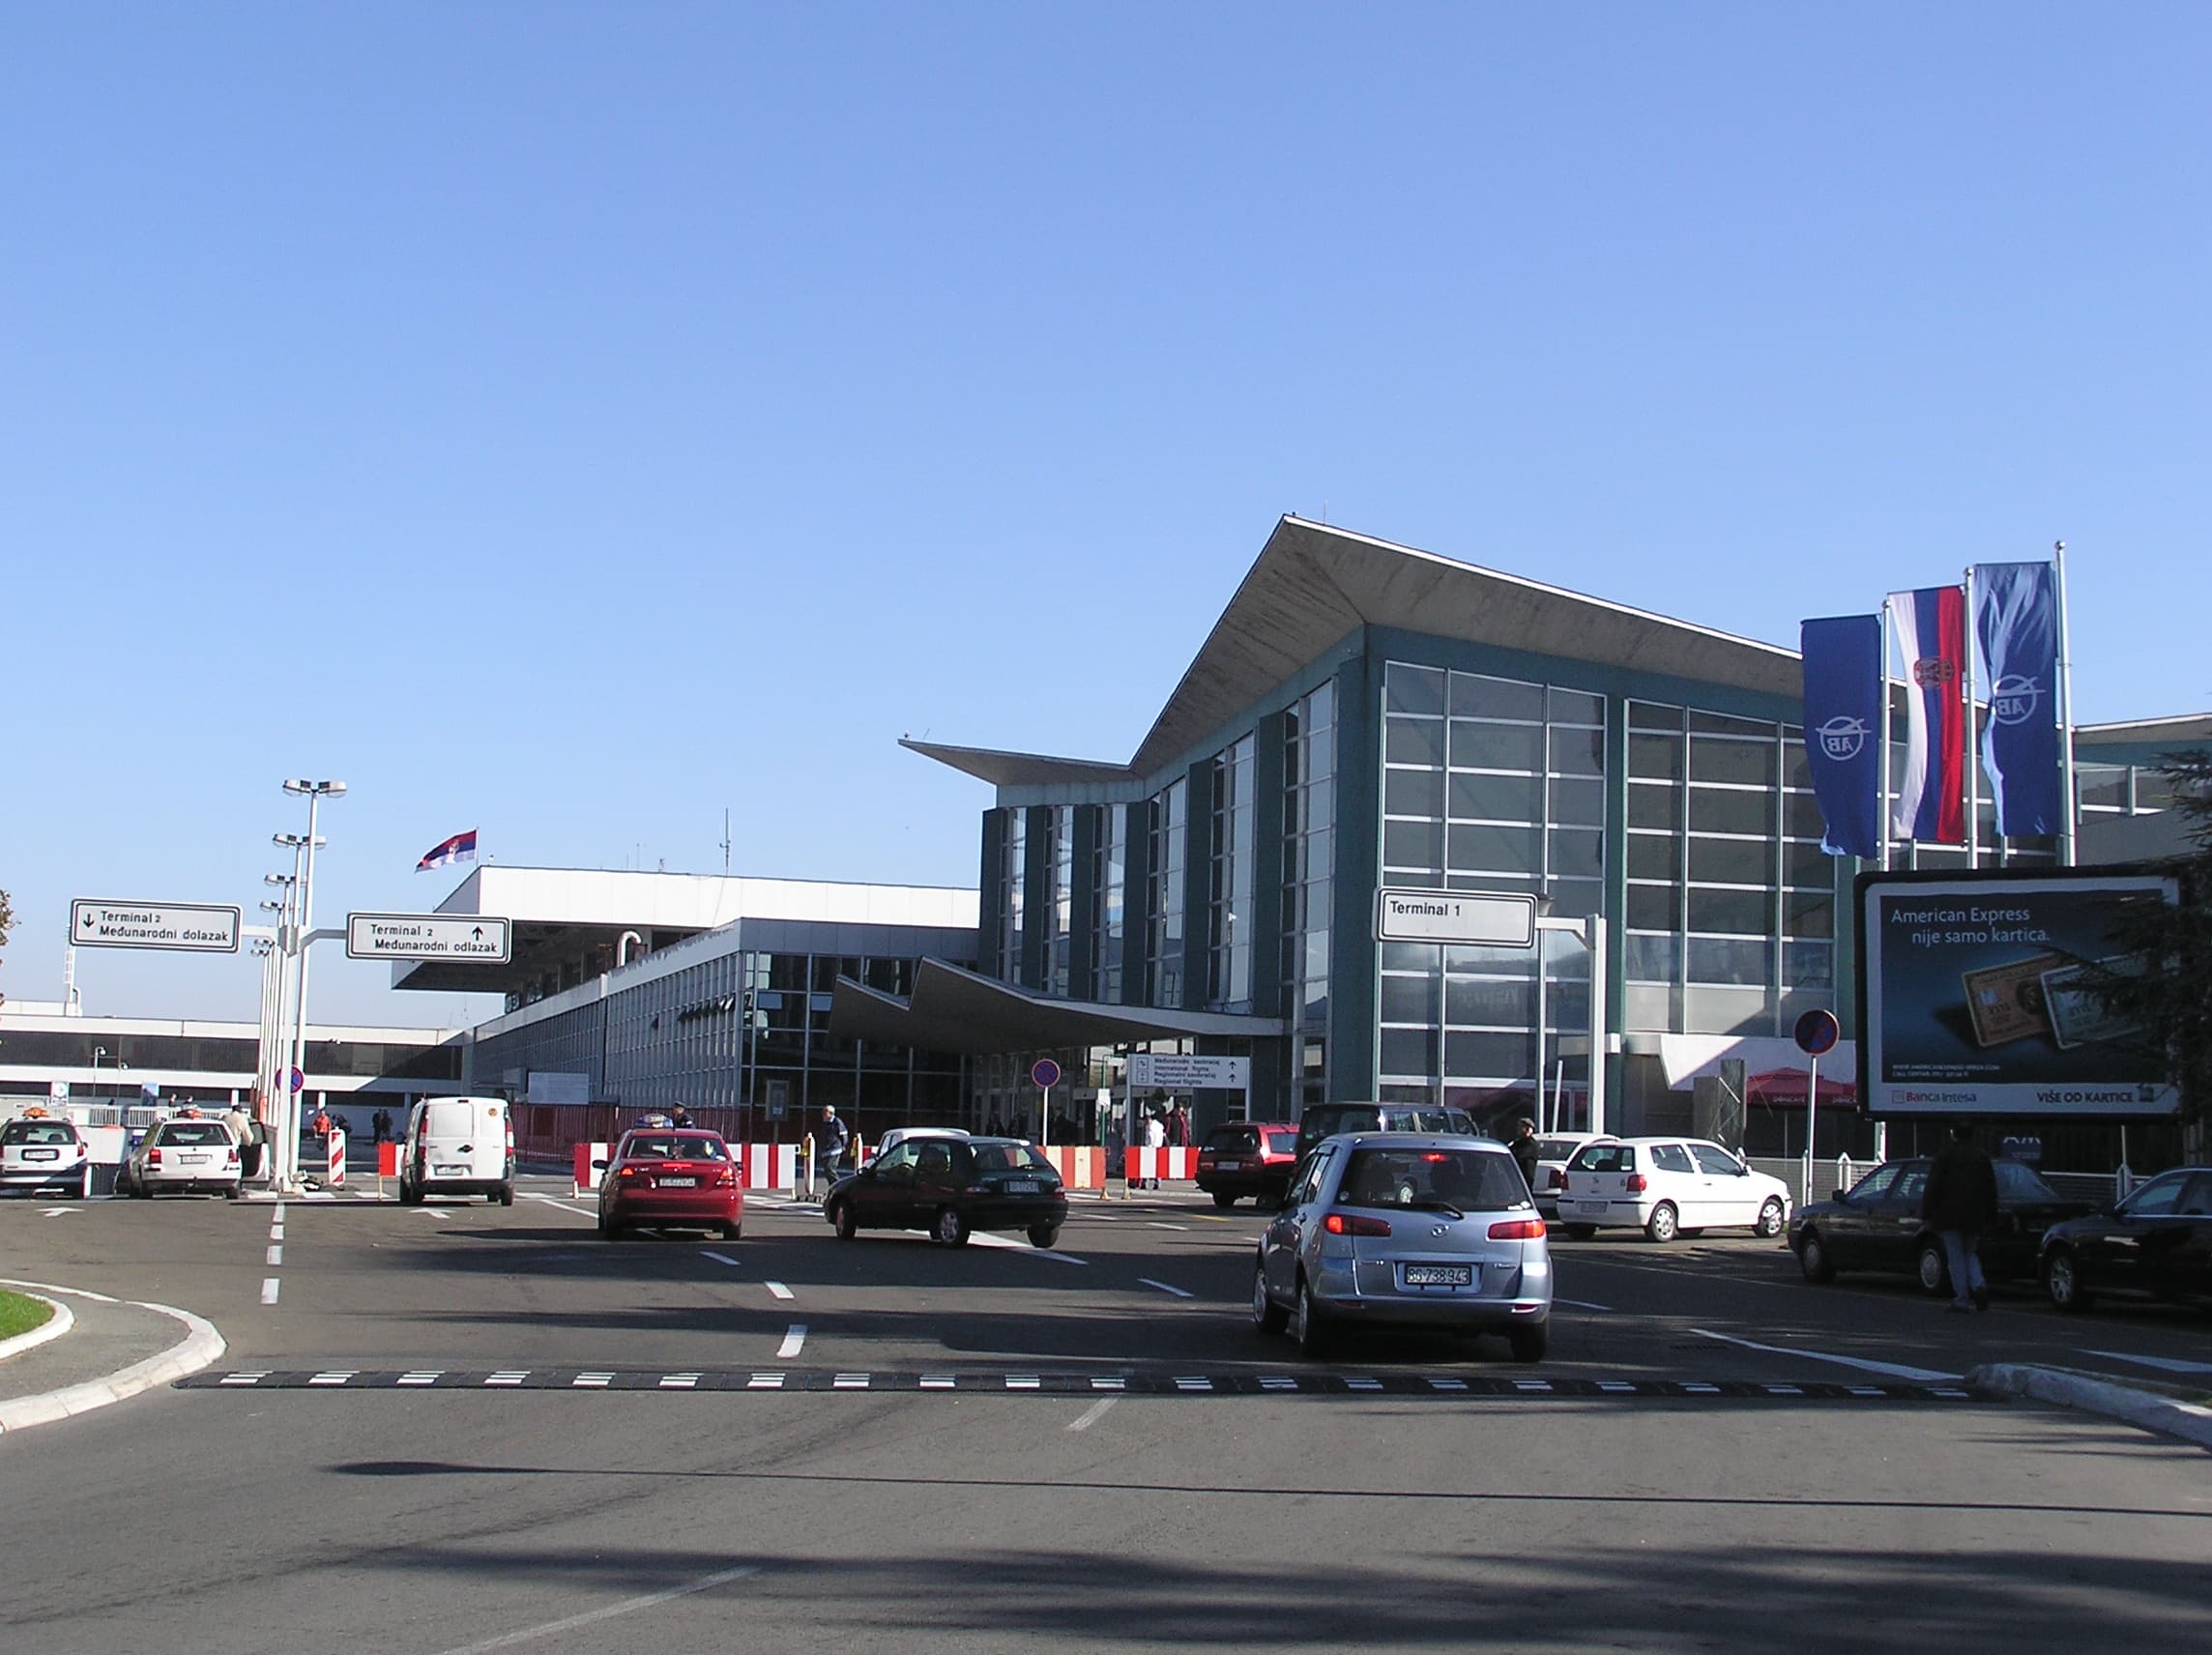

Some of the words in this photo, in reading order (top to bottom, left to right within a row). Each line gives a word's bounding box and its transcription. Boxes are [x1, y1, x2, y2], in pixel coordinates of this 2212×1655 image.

[1389, 900, 1448, 916] Terminal
[1454, 904, 1461, 916] 1
[101, 910, 153, 923] Terminal
[155, 915, 162, 923] 2
[1891, 907, 1966, 923] American
[1969, 907, 2030, 925] Express
[100, 924, 178, 940] Međunarodni
[183, 928, 228, 942] dolazak
[371, 923, 422, 937] Terminal
[427, 928, 434, 937] 2
[1911, 928, 1941, 948] nije
[1944, 932, 1988, 944] samo
[1991, 926, 2051, 943] kartica.
[453, 941, 498, 953] odlazak
[1906, 1091, 1939, 1102] Banca
[2036, 1089, 2061, 1103] VIŠE
[2063, 1091, 2082, 1103] OD
[2084, 1091, 2134, 1103] KARTICE
